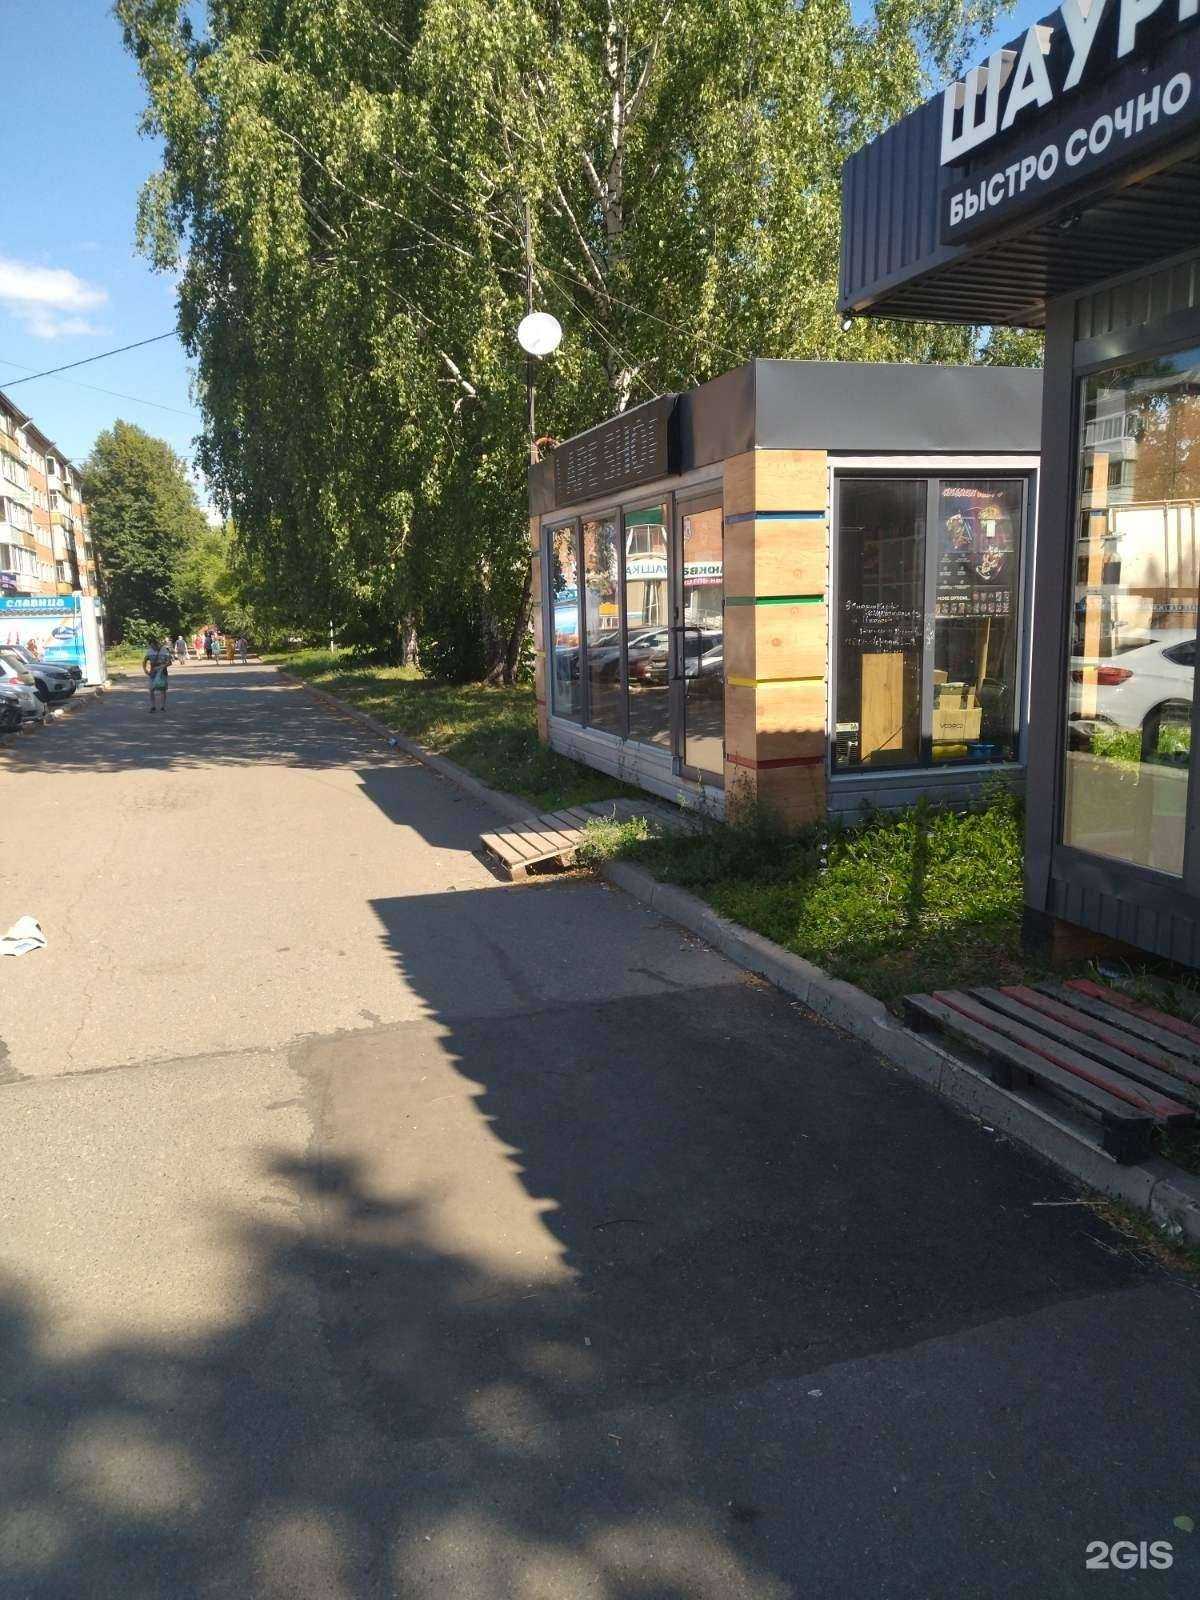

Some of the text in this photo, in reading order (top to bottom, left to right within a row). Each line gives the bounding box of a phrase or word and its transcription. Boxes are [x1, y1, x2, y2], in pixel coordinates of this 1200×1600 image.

[940, 0, 1200, 166] ШАУР
[950, 72, 1192, 227] БЫСТРО СОЧНО
